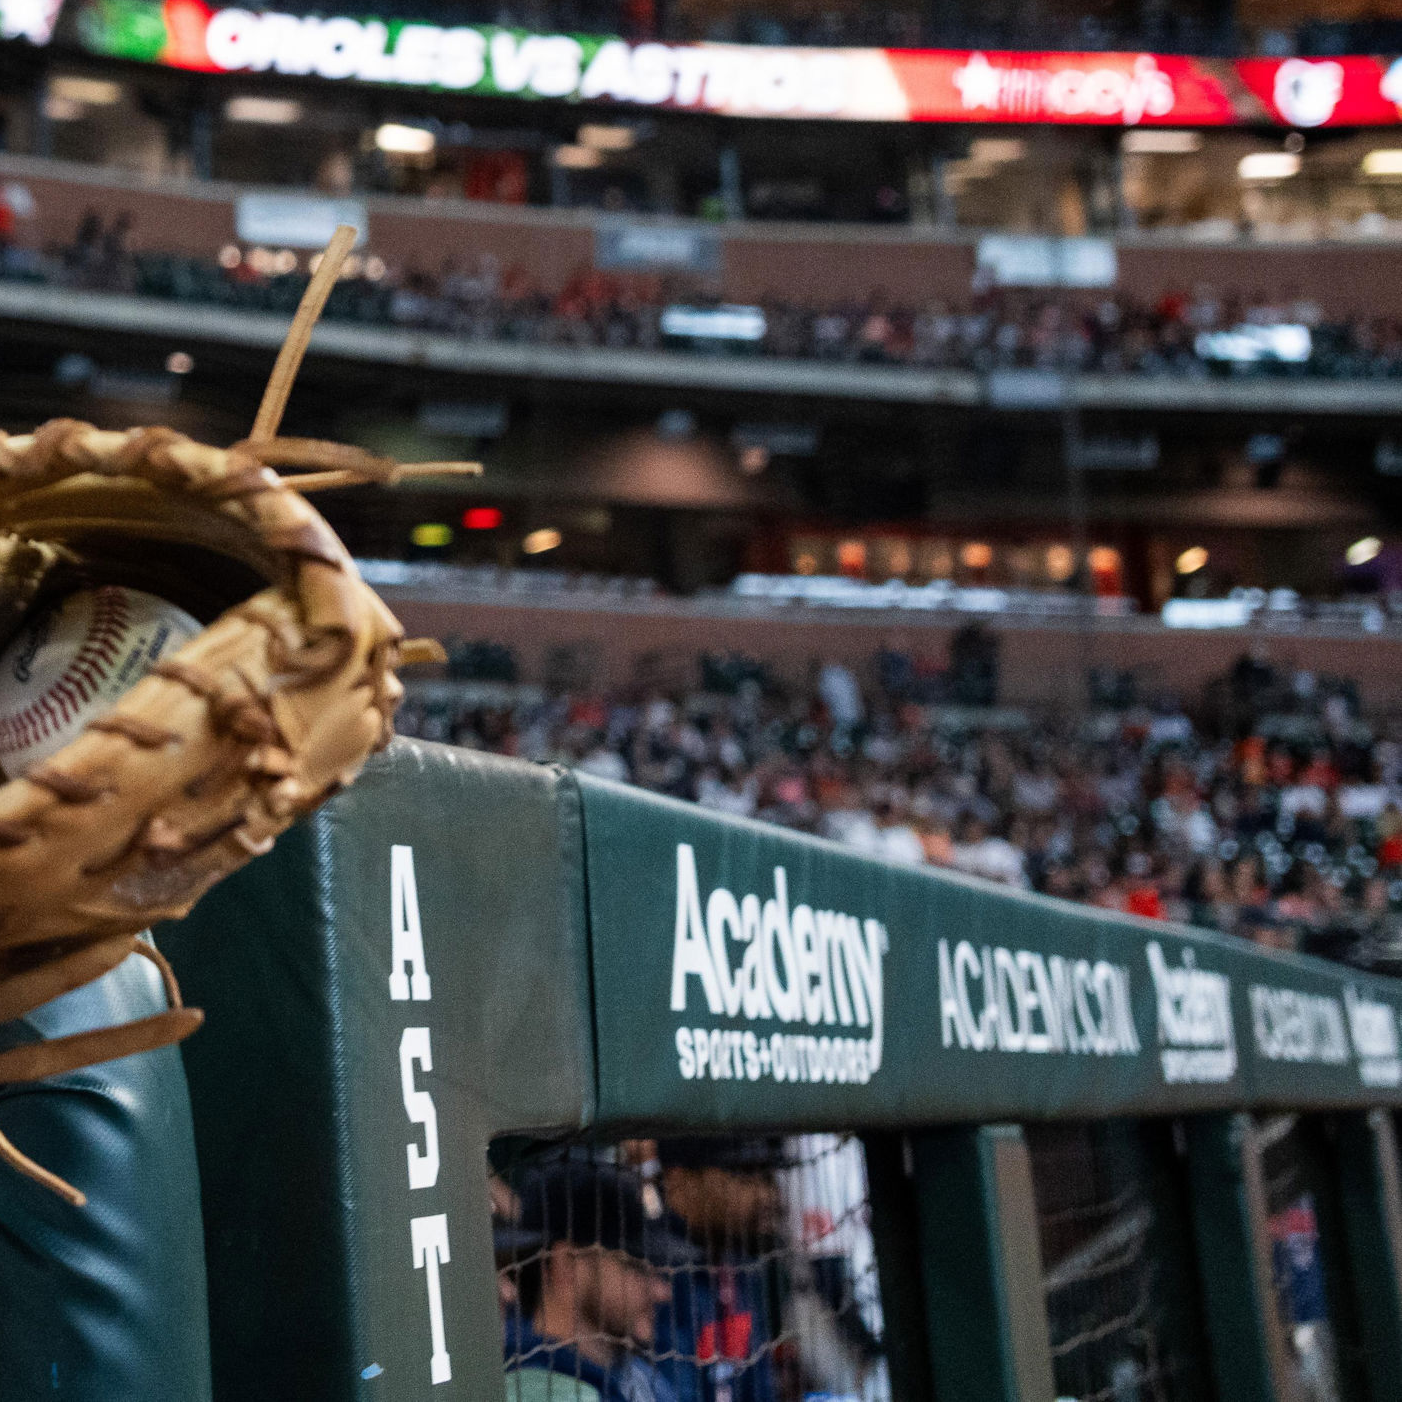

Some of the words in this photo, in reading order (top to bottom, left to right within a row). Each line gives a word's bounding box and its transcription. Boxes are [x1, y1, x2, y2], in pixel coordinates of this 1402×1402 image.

[206, 8, 486, 89] ORIOLES
[490, 32, 582, 96] VS
[670, 842, 886, 1075] Academy
[388, 844, 452, 1386] AST
